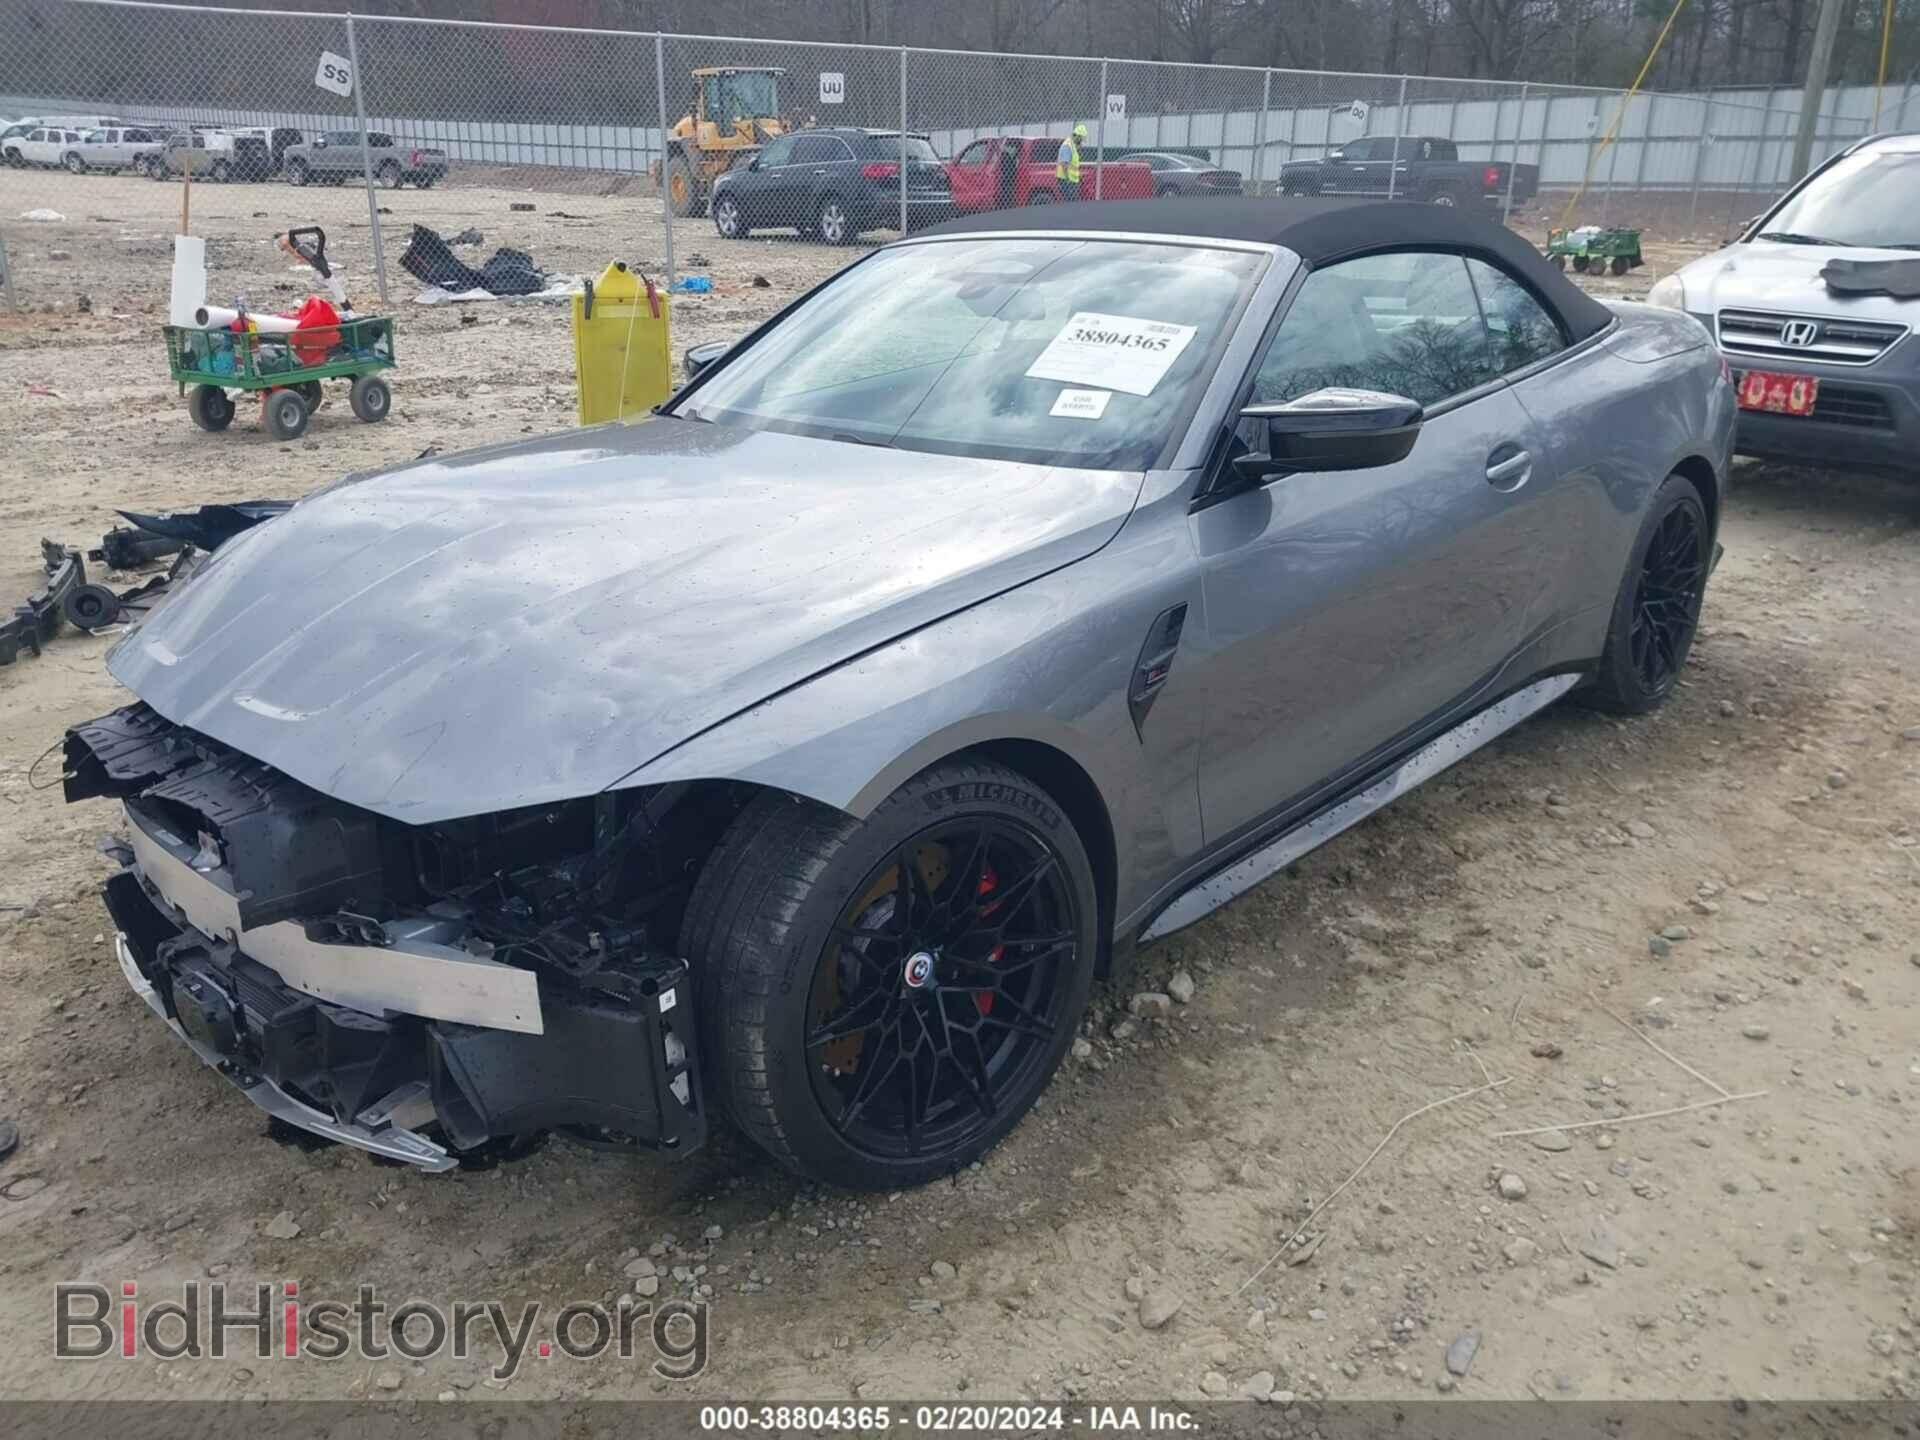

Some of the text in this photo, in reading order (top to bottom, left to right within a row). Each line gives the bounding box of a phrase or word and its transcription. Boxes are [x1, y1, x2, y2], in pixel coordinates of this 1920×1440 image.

[324, 64, 349, 84] SS
[823, 82, 841, 94] UU
[1068, 328, 1171, 351] 38804365
[957, 783, 1062, 829] MICHELIN
